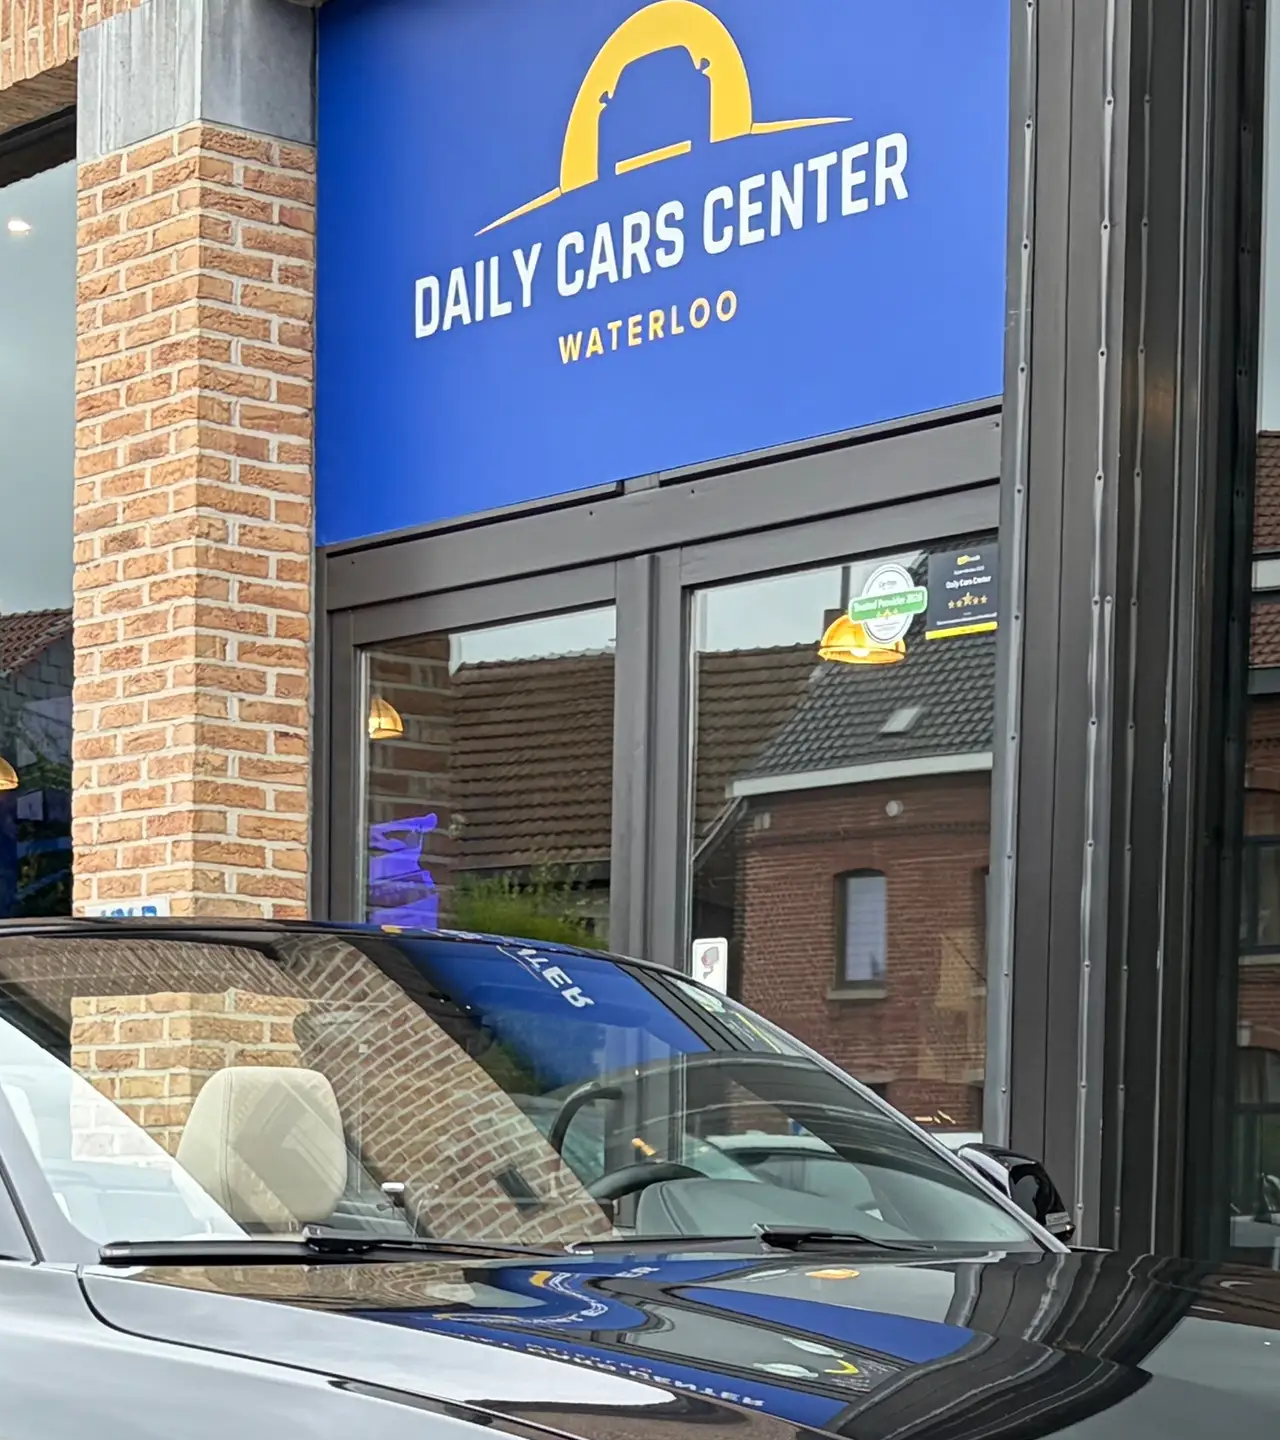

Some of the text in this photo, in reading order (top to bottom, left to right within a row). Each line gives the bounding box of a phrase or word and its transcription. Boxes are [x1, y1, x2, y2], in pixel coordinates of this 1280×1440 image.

[414, 132, 909, 338] DAILY CARS CENTER
[559, 290, 738, 364] WATERLOO
